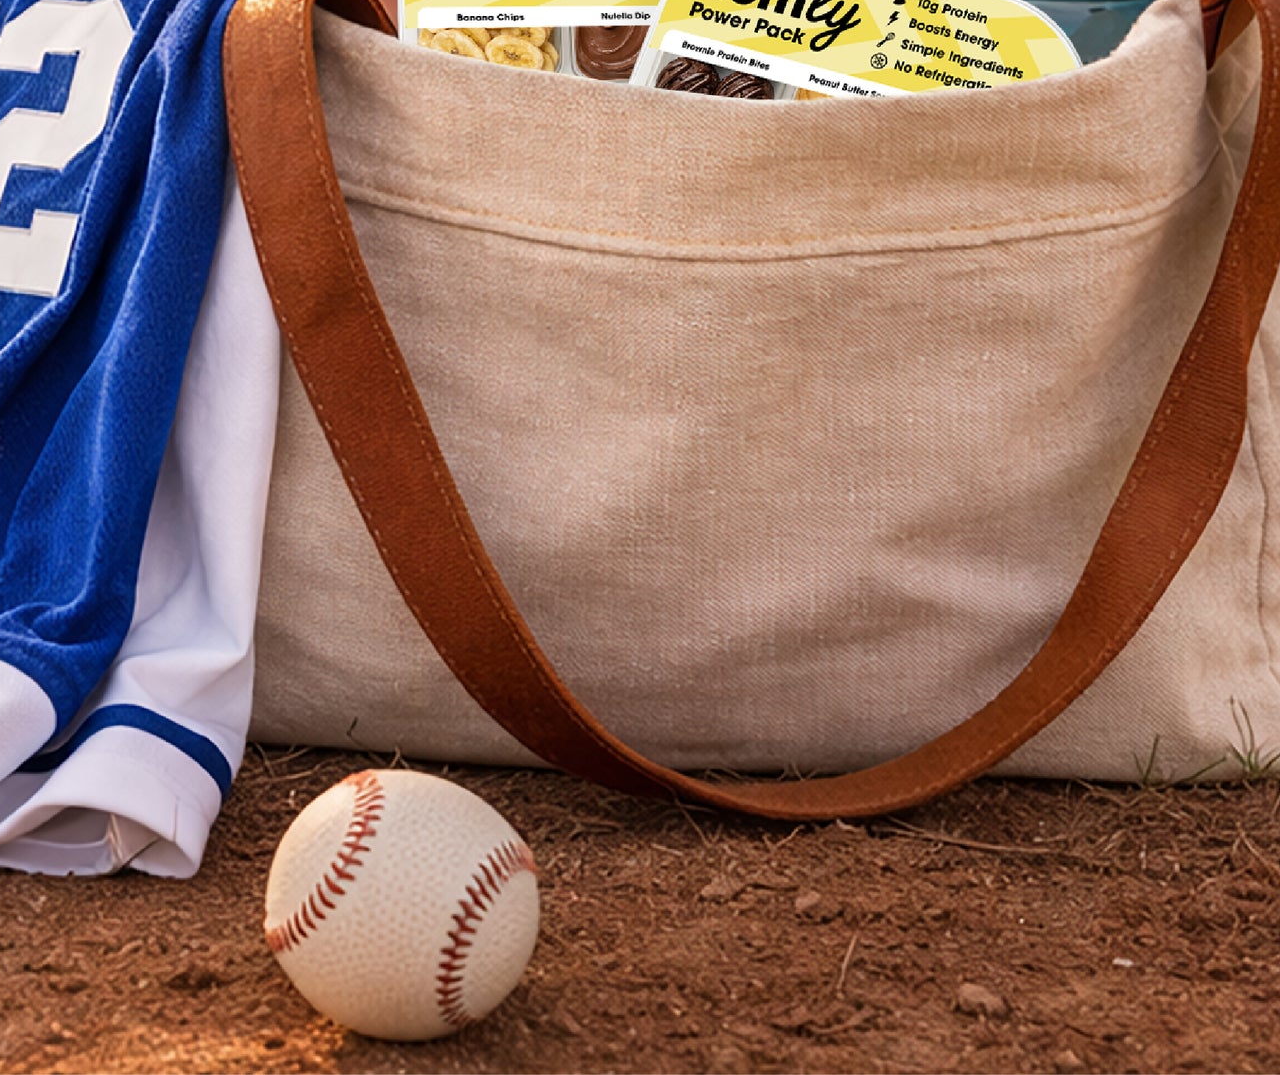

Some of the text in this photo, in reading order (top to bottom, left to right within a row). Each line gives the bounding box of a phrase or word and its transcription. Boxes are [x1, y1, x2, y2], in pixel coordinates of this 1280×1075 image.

[457, 13, 525, 22] Banana Chips
[635, 12, 651, 21] Dip
[689, 1, 806, 45] Power Pack
[941, 4, 988, 24] Protein
[909, 18, 999, 52] Boosts Energy
[681, 40, 770, 71] Brownie Protein Bites
[901, 39, 1024, 79] Simple Ingredients
[809, 74, 840, 89] Peanut
[894, 60, 992, 89] No Refrigerati
